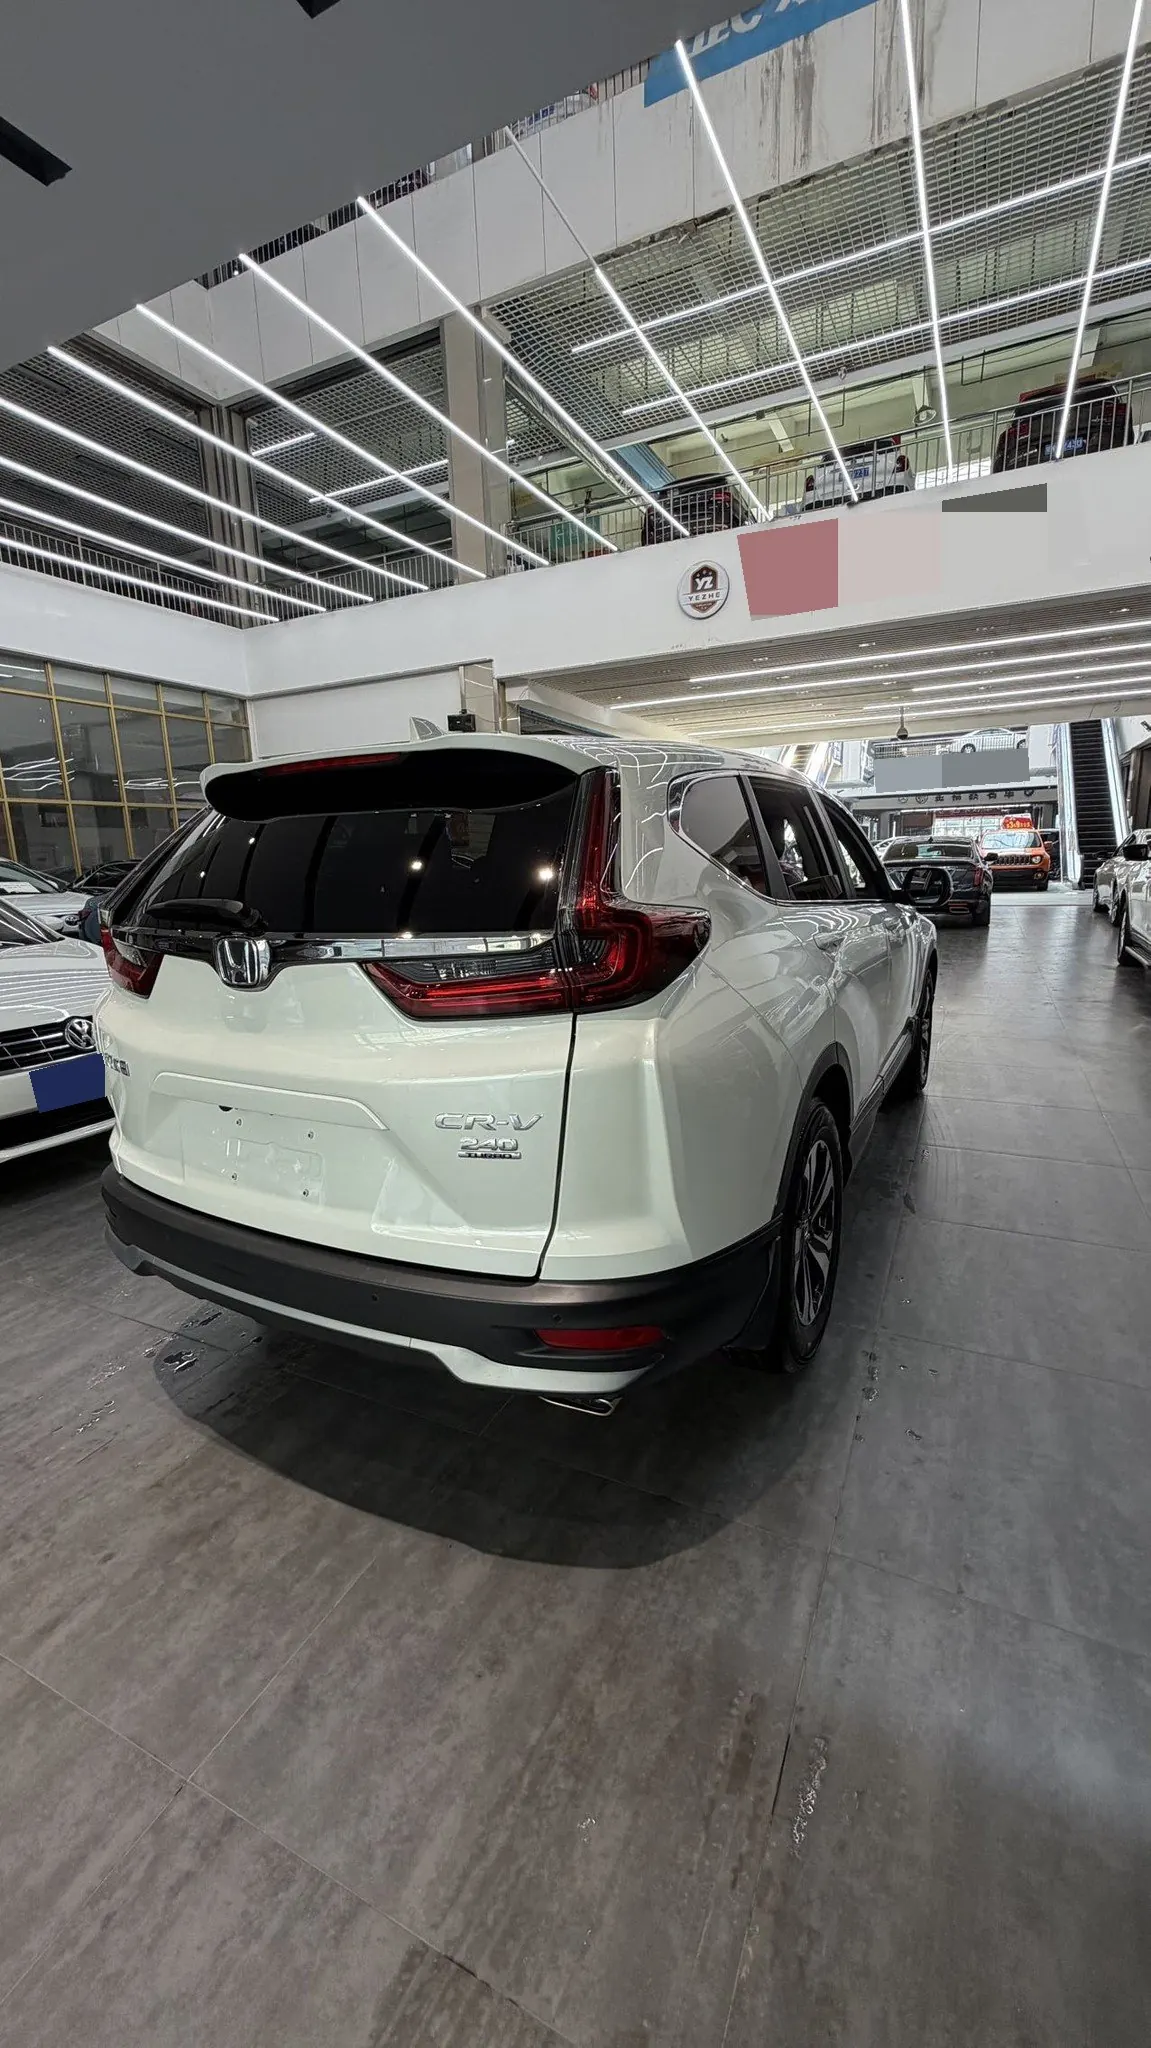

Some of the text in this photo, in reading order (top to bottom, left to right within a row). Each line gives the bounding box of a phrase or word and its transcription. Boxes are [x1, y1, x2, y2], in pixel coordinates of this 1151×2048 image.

[695, 576, 713, 591] YZ
[688, 591, 721, 602] YEZHE
[434, 1112, 544, 1131] CR-V
[460, 1136, 519, 1152] 240
[464, 1151, 515, 1160] TURBO
